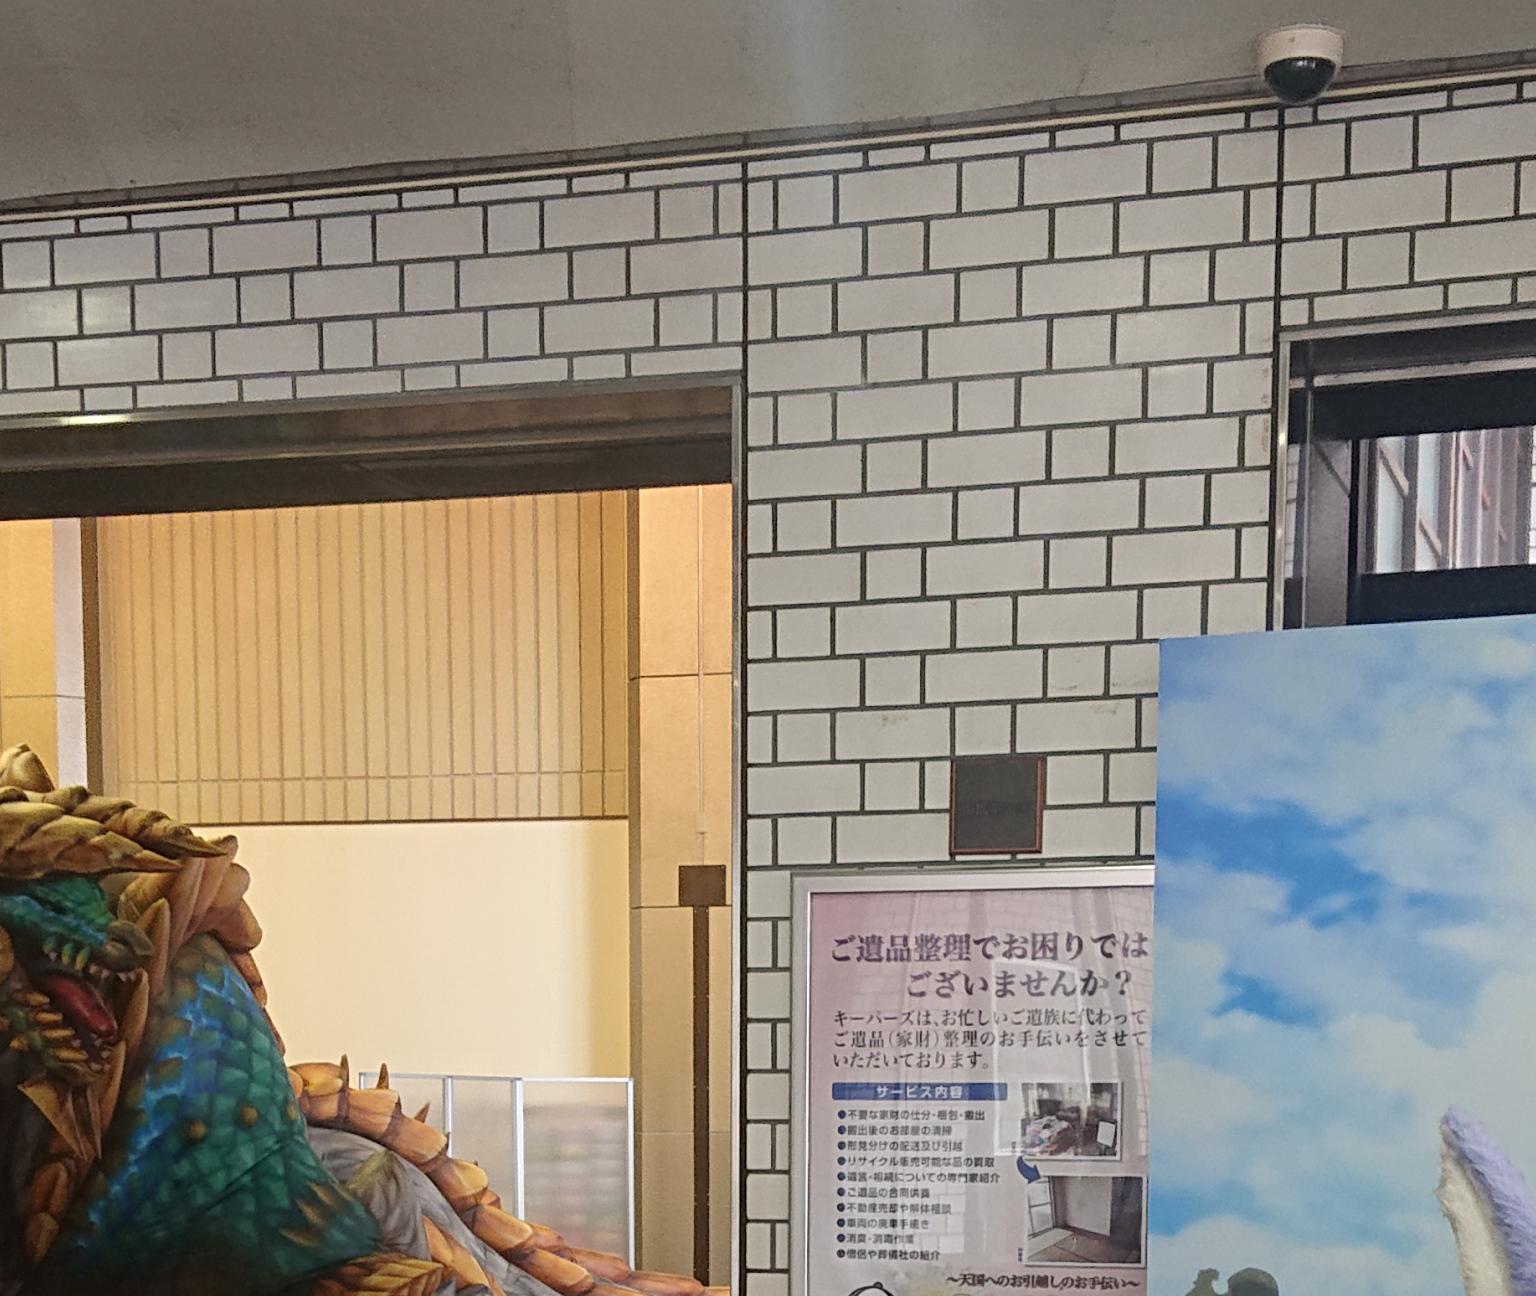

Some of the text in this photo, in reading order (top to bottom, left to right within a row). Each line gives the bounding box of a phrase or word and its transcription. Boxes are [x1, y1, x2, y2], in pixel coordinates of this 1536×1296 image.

[832, 932, 1149, 962] ご遺品整理でお困りでは
[907, 969, 1132, 998] ございませんか？
[833, 1052, 990, 1070] いただいております。
[877, 1085, 963, 1099] サービス内容
